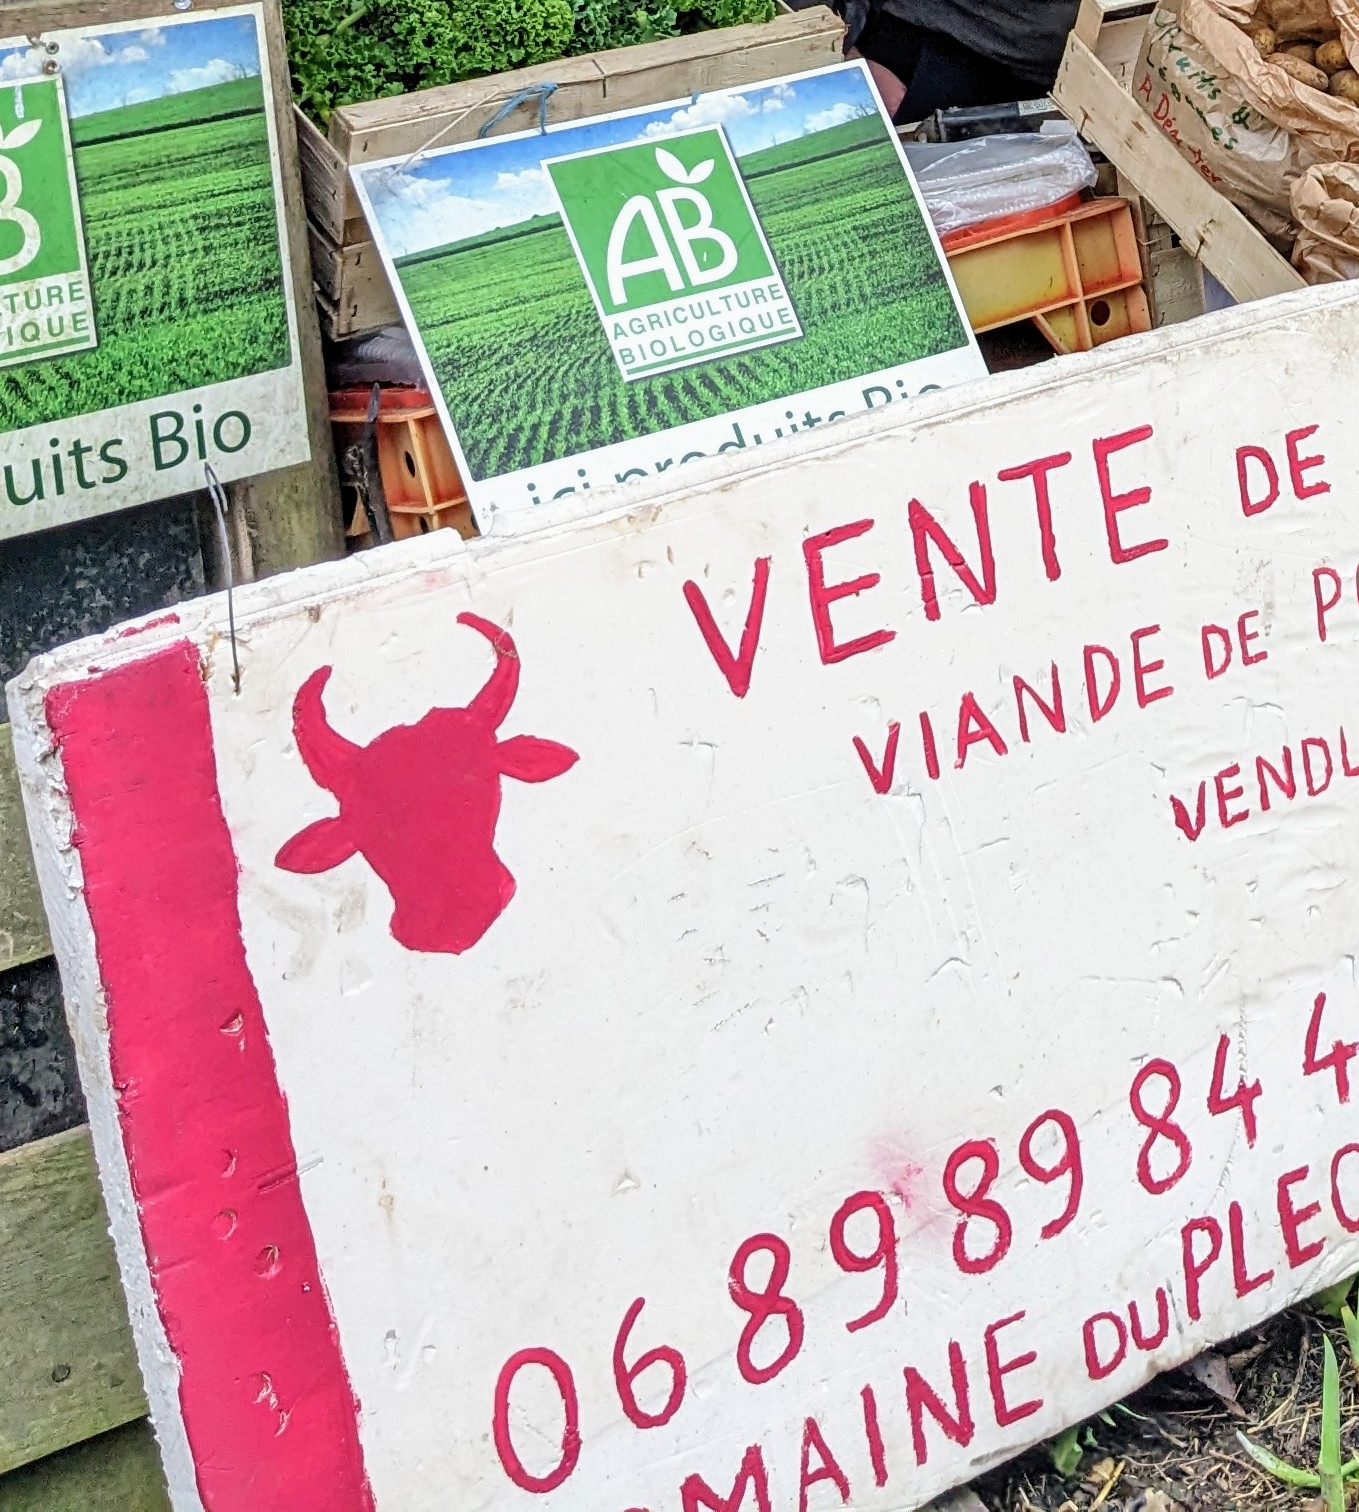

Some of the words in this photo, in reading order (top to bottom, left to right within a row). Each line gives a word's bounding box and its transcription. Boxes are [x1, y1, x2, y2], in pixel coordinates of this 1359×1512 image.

[606, 186, 738, 305] AB
[0, 280, 85, 317] TURE
[613, 283, 784, 340] AGRICULTURE
[619, 307, 794, 365] BIOLOGIQUE
[150, 403, 252, 473] Bio
[682, 424, 1173, 700] VENTE
[1235, 424, 1331, 517] DE
[852, 624, 1175, 794] VIANDE
[1201, 610, 1268, 680] DE
[613, 1309, 1045, 1512] MAINE
[1082, 1285, 1170, 1380] DU
